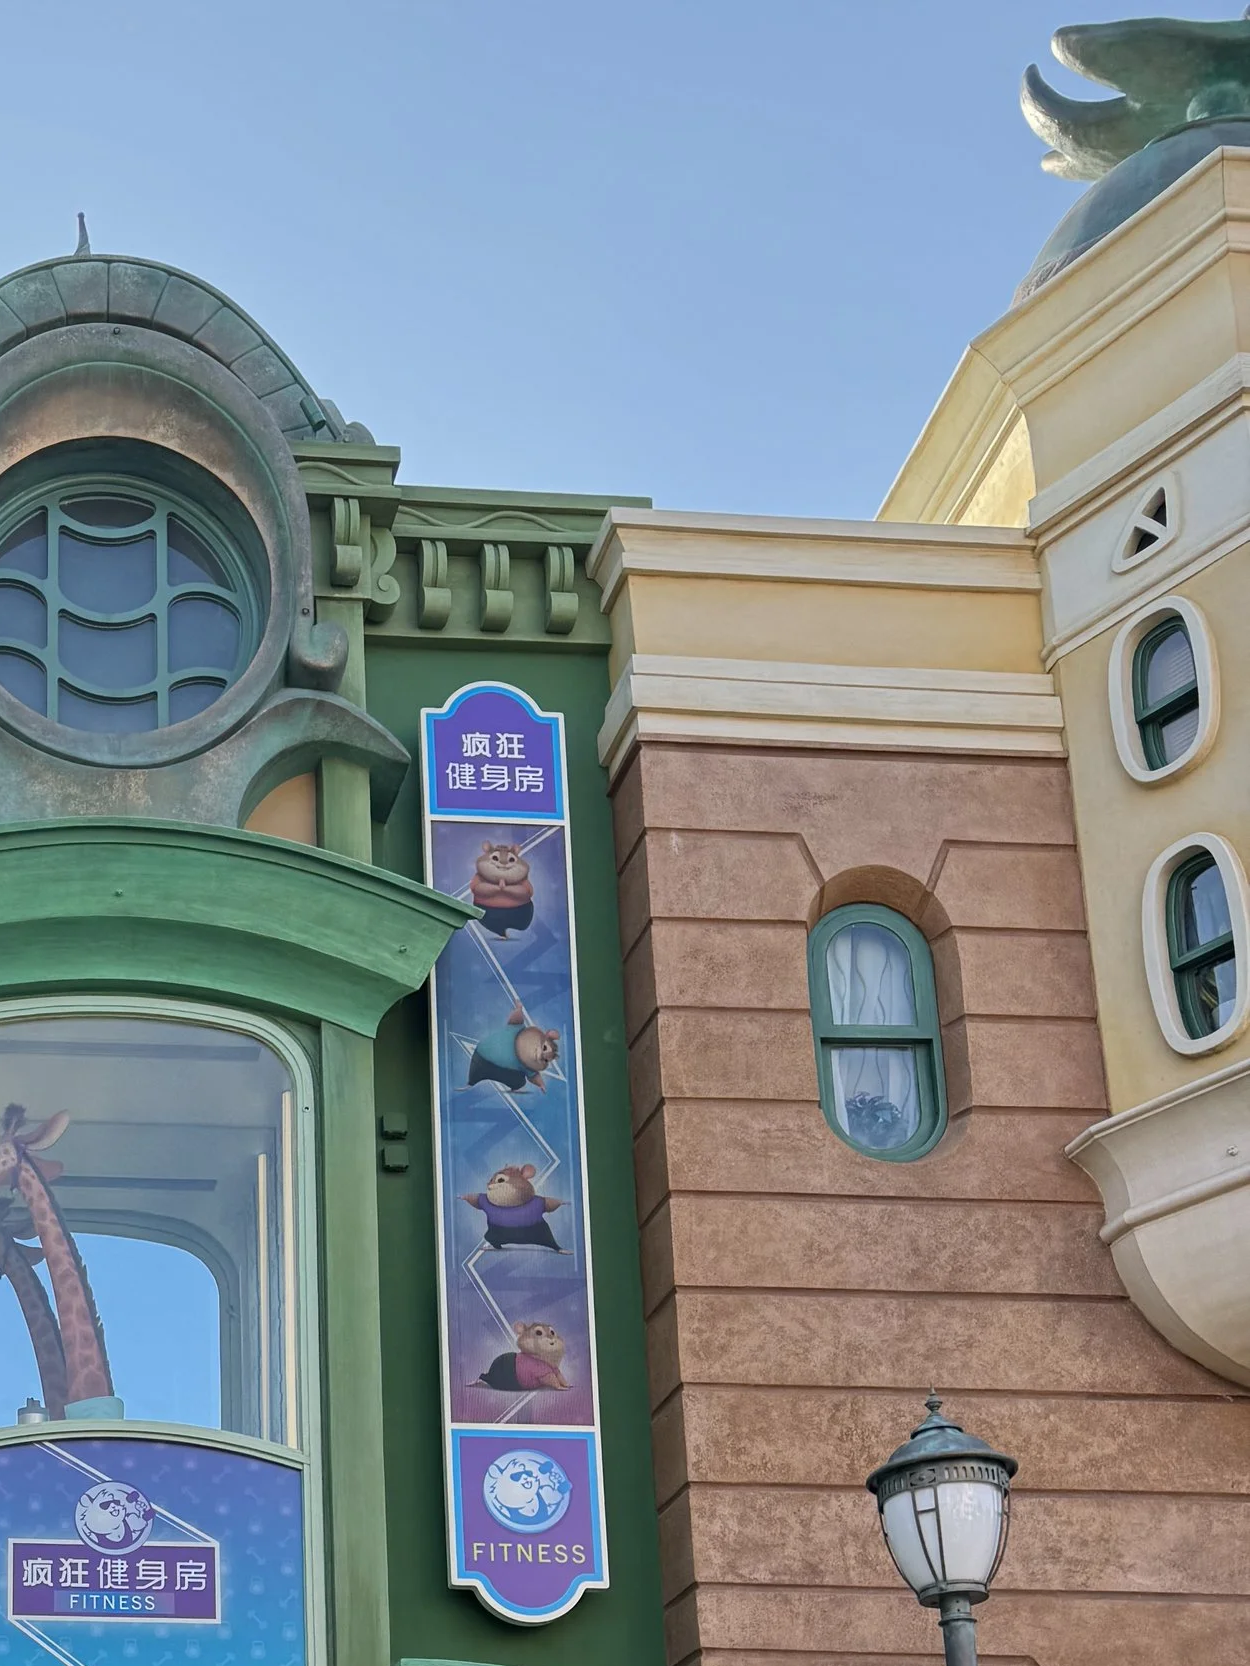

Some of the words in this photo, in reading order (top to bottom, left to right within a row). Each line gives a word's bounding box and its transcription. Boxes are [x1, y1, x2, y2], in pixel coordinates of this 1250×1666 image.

[461, 731, 526, 759] 疯狂
[445, 762, 545, 793] 健身房
[472, 1542, 586, 1564] FITNESS
[22, 1557, 208, 1591] 疯狂健身房
[69, 1594, 156, 1611] FITNESS
